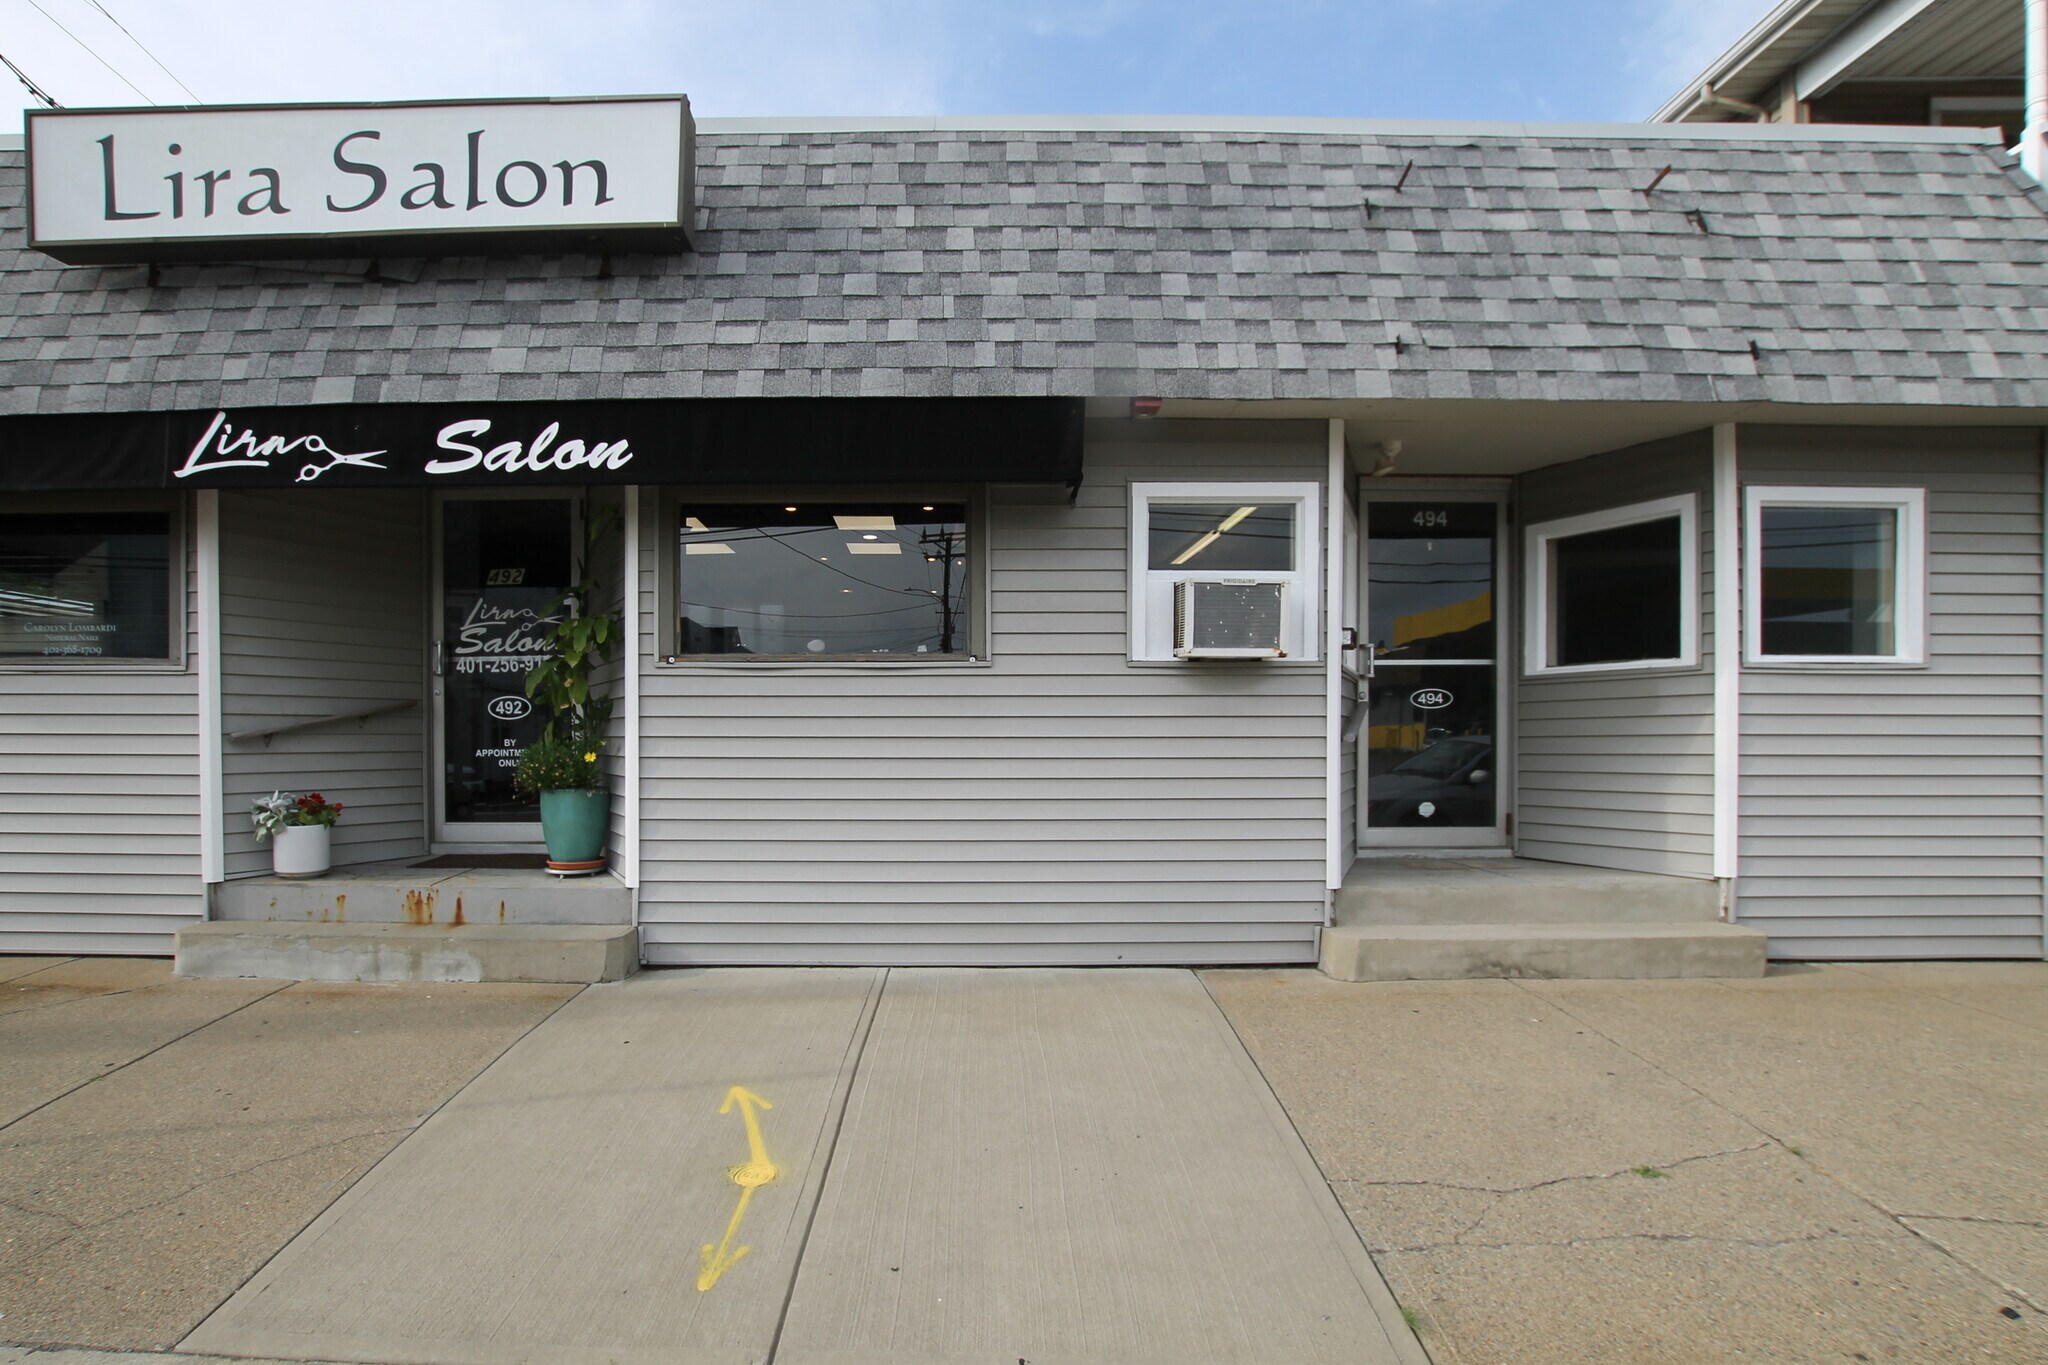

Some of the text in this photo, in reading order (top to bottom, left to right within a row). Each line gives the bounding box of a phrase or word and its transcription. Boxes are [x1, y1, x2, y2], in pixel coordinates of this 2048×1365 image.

[96, 129, 614, 221] Lira Salon
[173, 410, 633, 478] Lira Salon
[1413, 511, 1447, 527] 494
[488, 569, 523, 584] 492
[460, 597, 523, 630] Lira
[456, 656, 550, 674] 401-256-91
[1417, 692, 1443, 704] 494
[495, 700, 522, 715] 492
[503, 738, 517, 747] BY
[475, 749, 524, 757] APPOINTM
